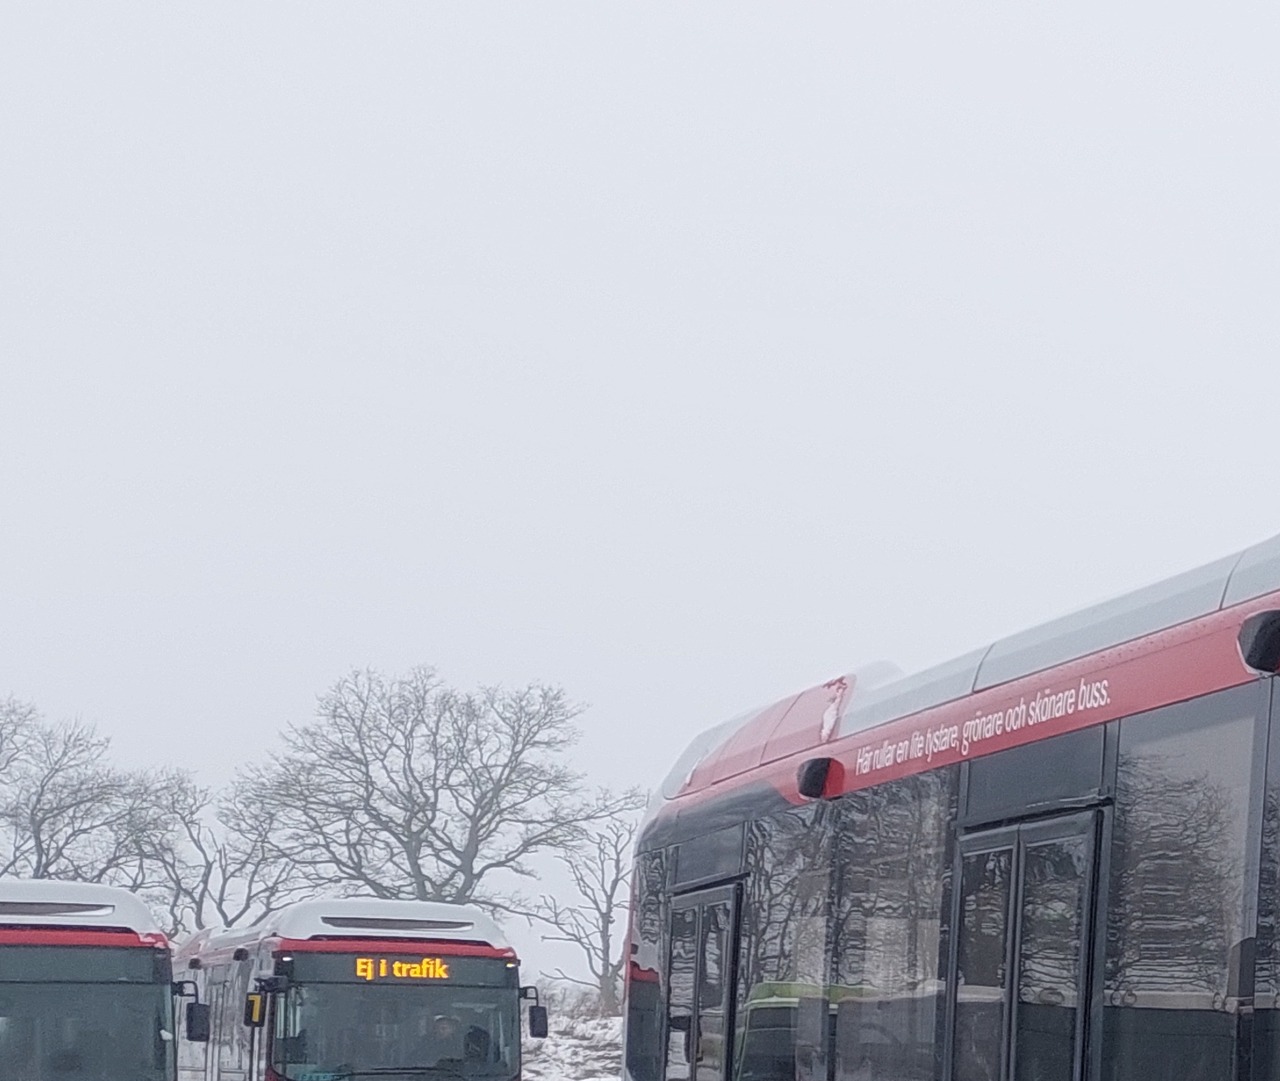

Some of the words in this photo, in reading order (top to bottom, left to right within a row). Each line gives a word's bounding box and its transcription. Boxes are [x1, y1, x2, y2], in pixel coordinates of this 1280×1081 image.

[873, 738, 896, 771] rullar
[896, 740, 909, 764] en
[908, 732, 925, 760] lite
[924, 722, 960, 763] tystare,
[961, 710, 1004, 756] grönare
[1005, 698, 1027, 734] och
[1028, 687, 1076, 726] skönare
[1077, 677, 1112, 712] buss.
[356, 957, 375, 981] Ej
[379, 958, 387, 977] i
[392, 957, 450, 979] trafik
